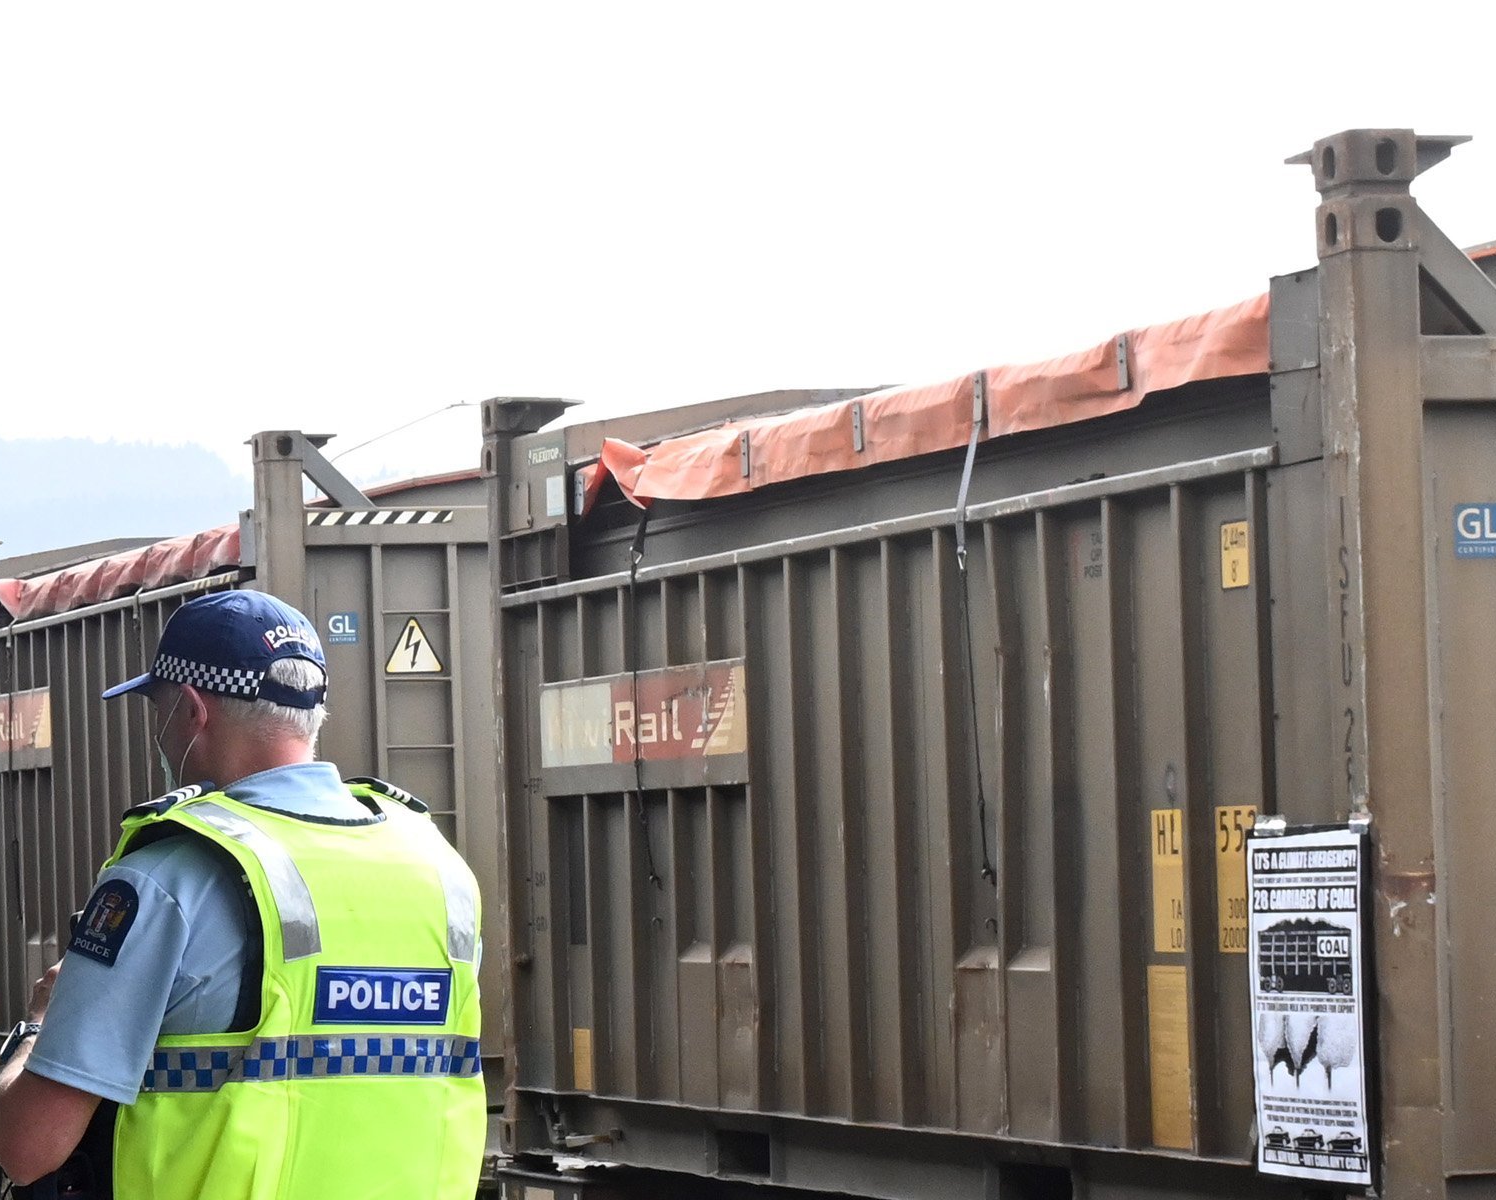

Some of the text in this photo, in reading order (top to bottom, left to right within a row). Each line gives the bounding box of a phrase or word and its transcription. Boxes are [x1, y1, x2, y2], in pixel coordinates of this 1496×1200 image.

[532, 448, 559, 464] FLEXITOP
[328, 614, 356, 634] GL
[1254, 852, 1270, 870] IT'S
[1271, 852, 1278, 869] A
[1254, 887, 1356, 910] 28 CARRIAGES OF COAL
[74, 937, 111, 958] POLICE
[1318, 939, 1347, 955] COAL
[328, 979, 441, 1011] POLICE
